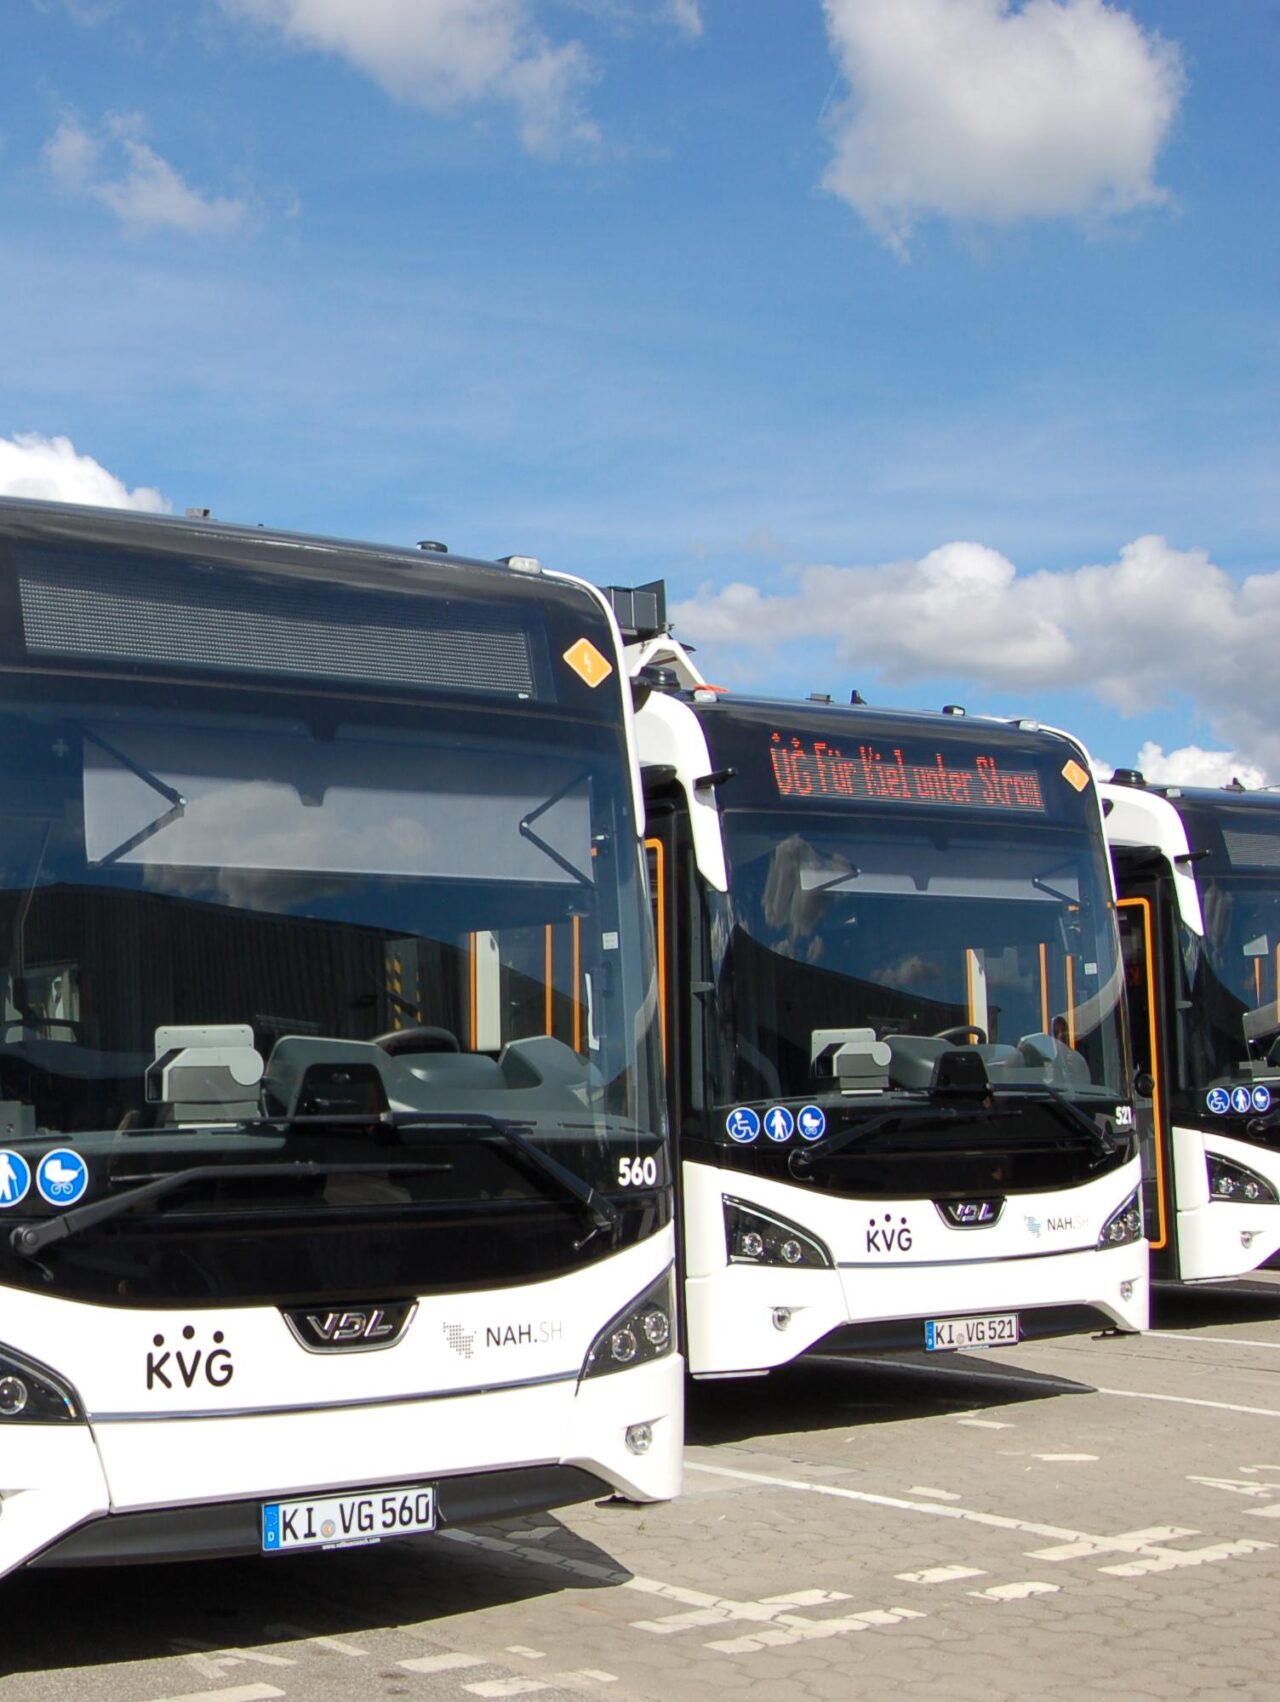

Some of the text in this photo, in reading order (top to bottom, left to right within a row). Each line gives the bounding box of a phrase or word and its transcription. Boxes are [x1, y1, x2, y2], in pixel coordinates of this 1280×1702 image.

[813, 742, 857, 795] Für
[859, 746, 912, 799] Kiel
[912, 752, 973, 802] unter
[976, 756, 1044, 807] Strom
[1115, 1106, 1132, 1126] 521
[618, 1156, 657, 1187] 560
[948, 1203, 994, 1222] VDL
[866, 1228, 913, 1254] KVG
[306, 1310, 394, 1340] VDL
[486, 1320, 562, 1348] NAH.SH
[935, 1324, 955, 1345] KI
[966, 1321, 986, 1342] VG
[988, 1318, 1015, 1340] 521
[146, 1349, 233, 1390] KVG
[282, 1507, 317, 1541] KI
[339, 1501, 374, 1534] VG
[381, 1493, 430, 1528] 560
